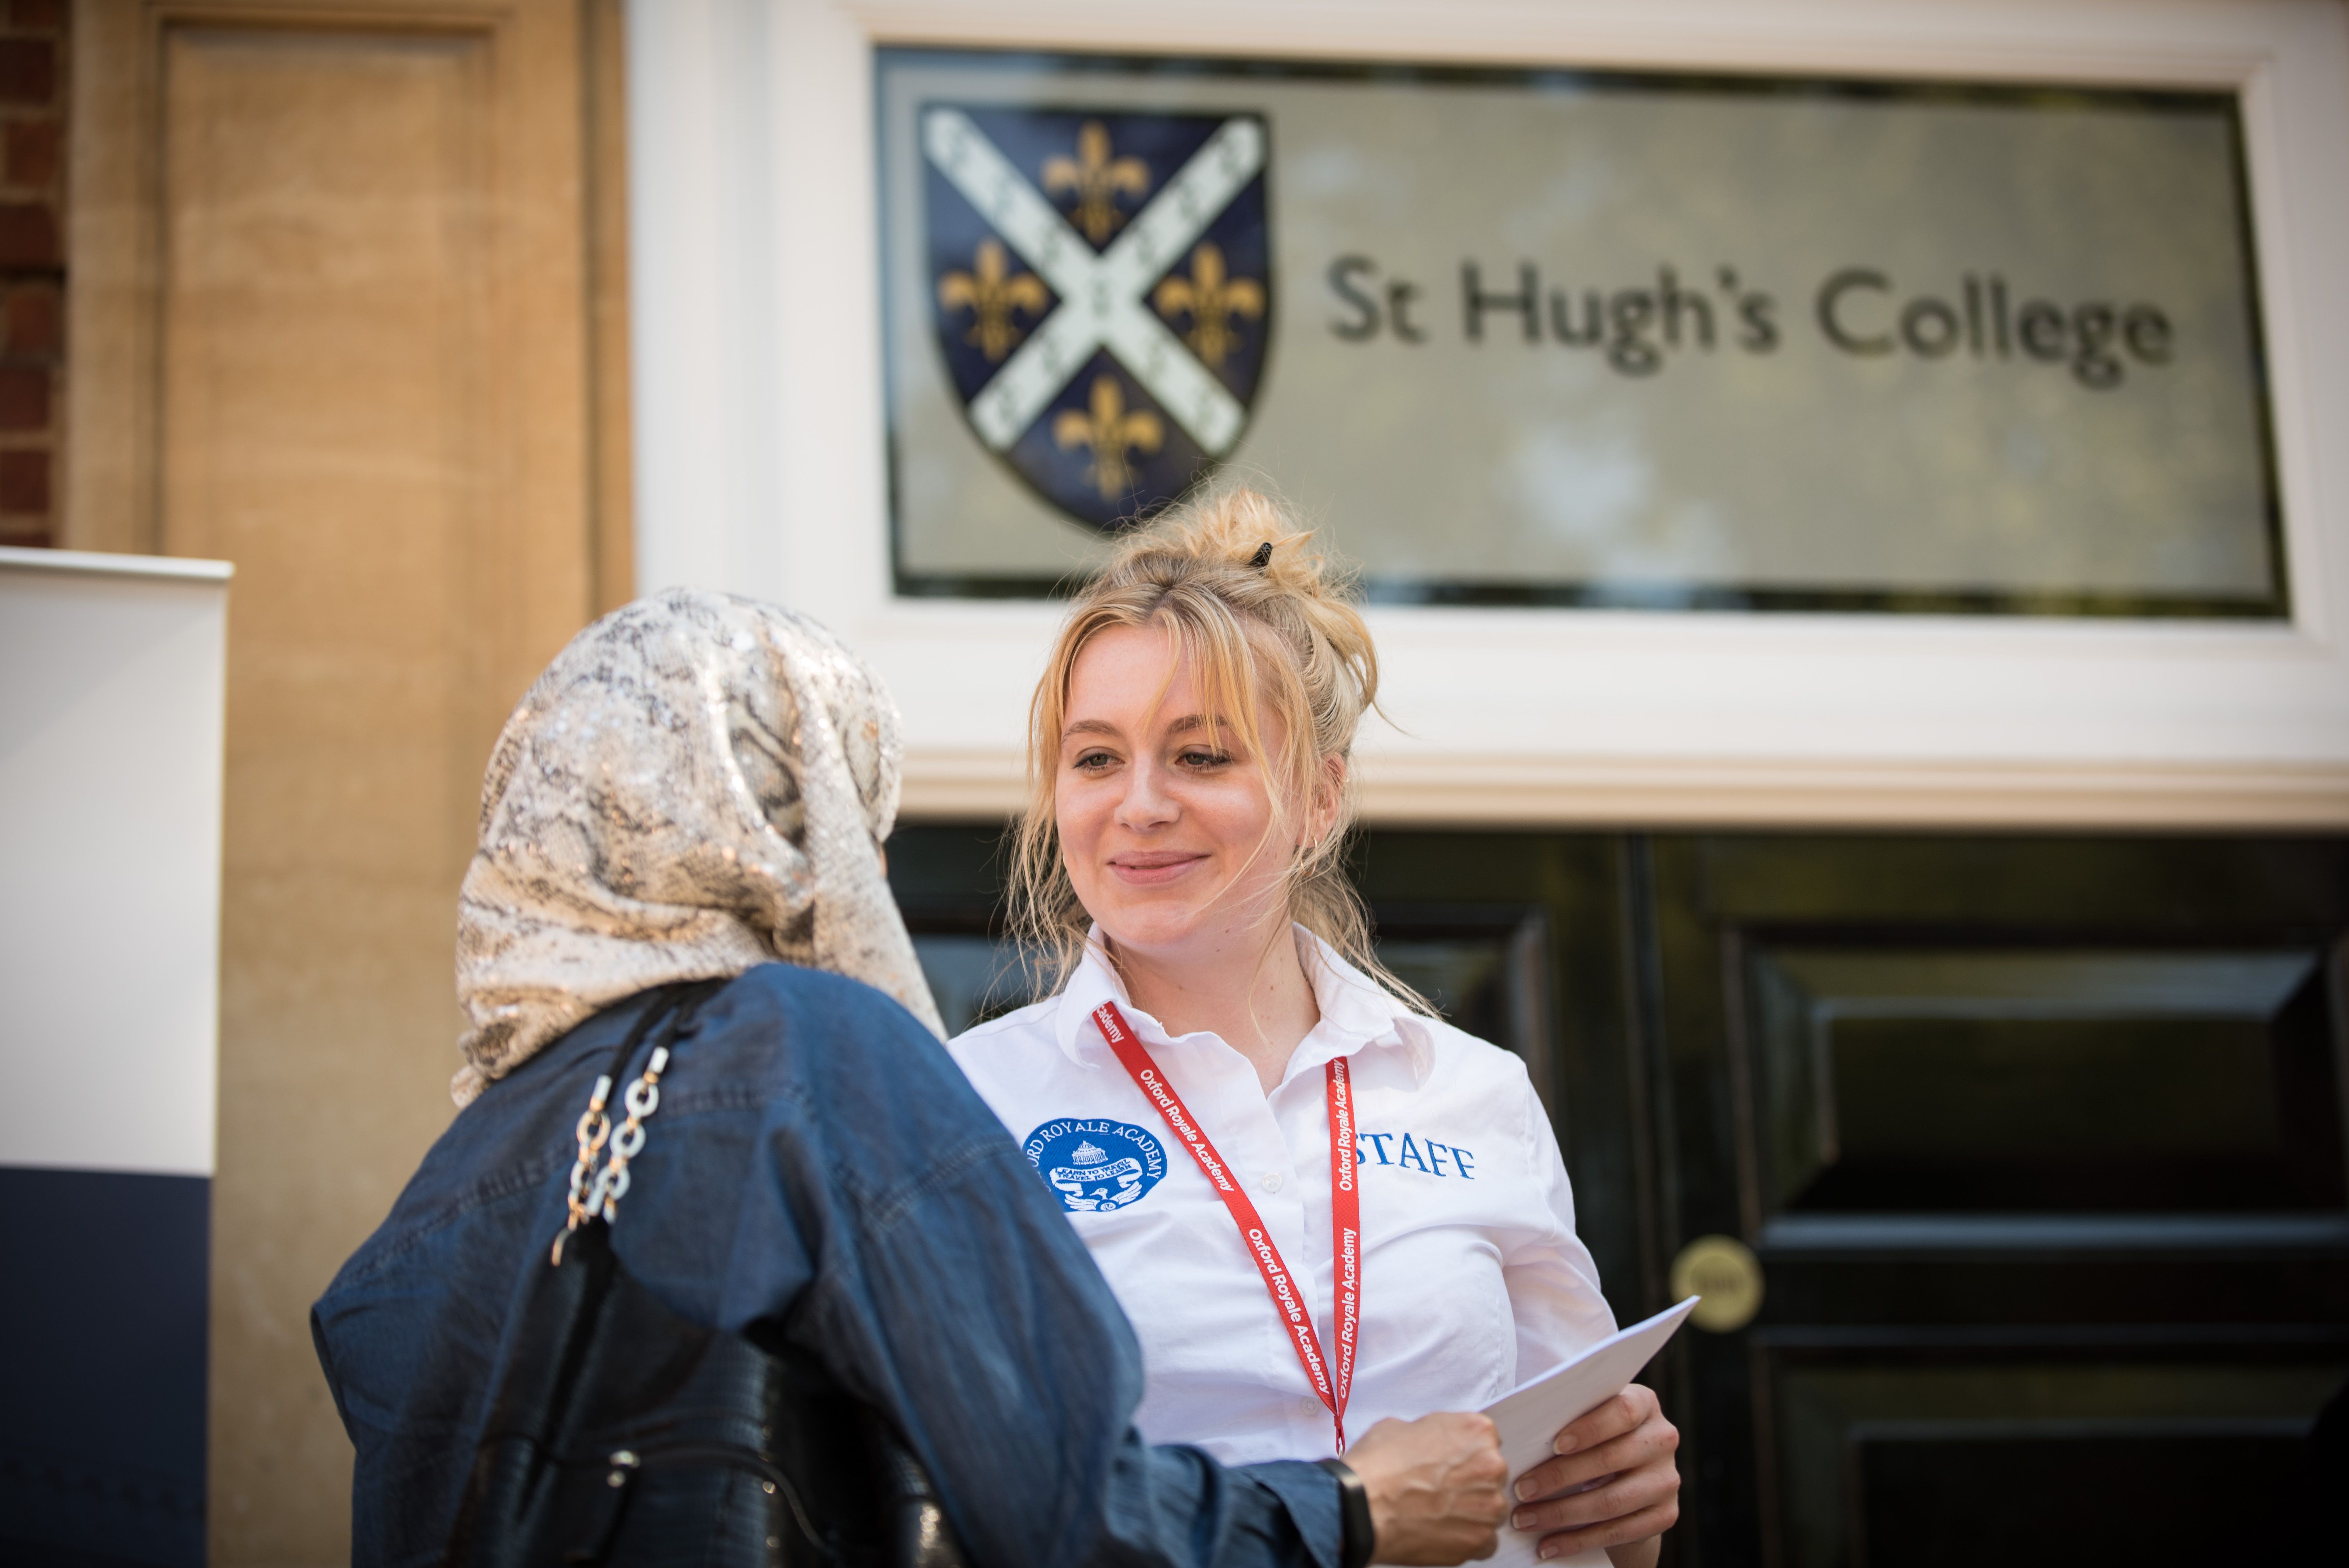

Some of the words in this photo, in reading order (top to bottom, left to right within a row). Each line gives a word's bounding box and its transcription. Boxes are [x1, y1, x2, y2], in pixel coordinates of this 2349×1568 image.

[1326, 256, 1427, 346] St
[1460, 261, 1780, 378] Hugh's
[1816, 267, 2174, 390] College
[1096, 1005, 1124, 1043] cademy
[1333, 1058, 1347, 1110] Academy
[1027, 1139, 1044, 1167] ORD
[1039, 1122, 1110, 1142] ROYALE
[1112, 1126, 1162, 1179] ACADEMY
[1140, 1069, 1173, 1108] Oxford
[1166, 1105, 1196, 1142] Royale
[1192, 1143, 1234, 1192] Academy
[1336, 1110, 1352, 1148] Royale
[1338, 1148, 1352, 1191] Oxford
[1342, 1228, 1356, 1290] Academy
[1249, 1229, 1282, 1274] Oxford
[1272, 1273, 1301, 1322] Royale
[1294, 1324, 1329, 1394] Academy
[1342, 1293, 1356, 1343] Royale
[1340, 1343, 1352, 1399] Oxford
